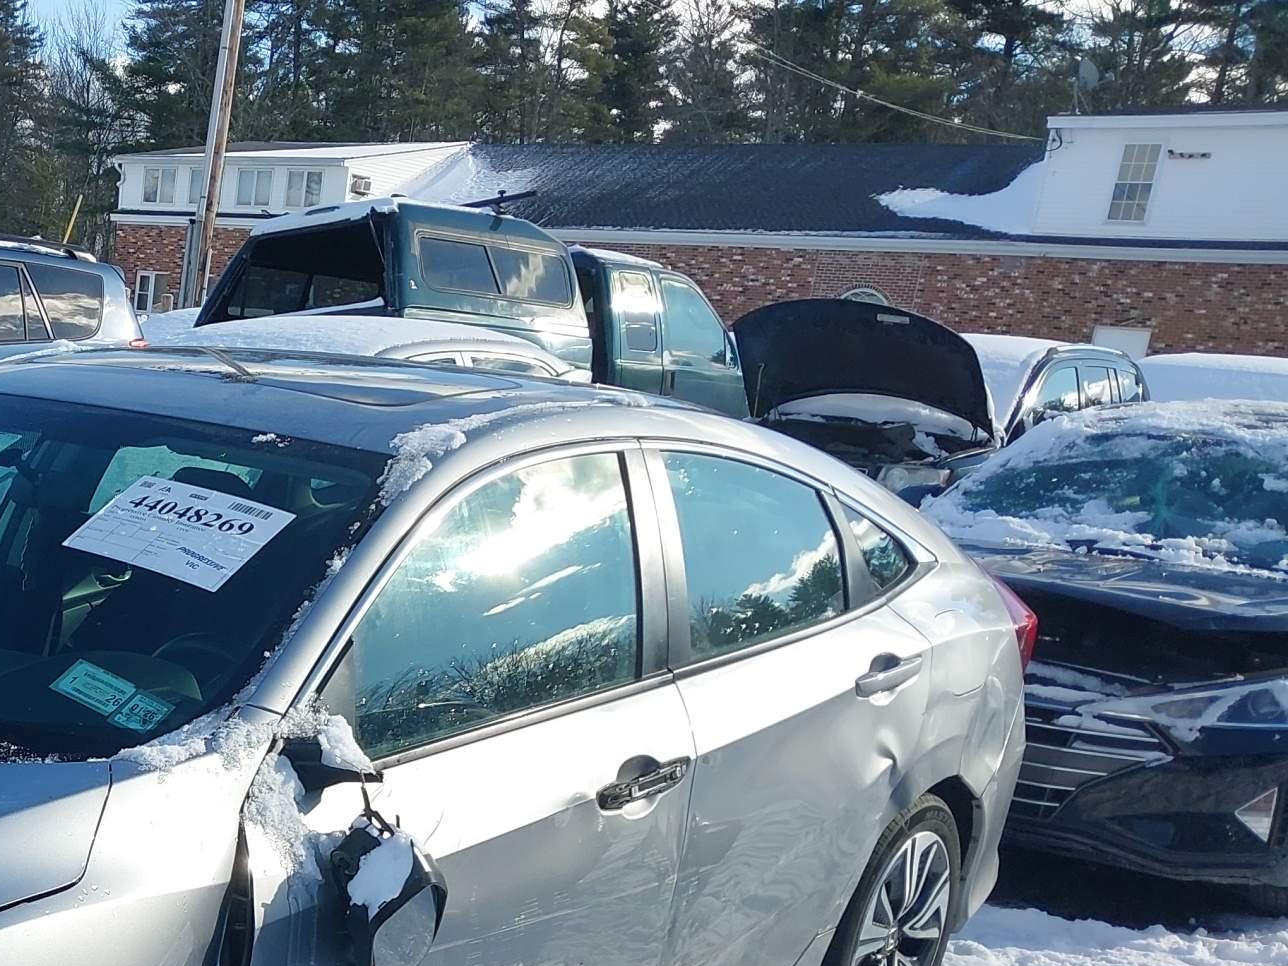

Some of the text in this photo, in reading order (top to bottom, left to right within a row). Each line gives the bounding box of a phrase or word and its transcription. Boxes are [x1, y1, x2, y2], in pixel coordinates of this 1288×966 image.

[129, 495, 255, 537] 44048269
[185, 559, 200, 570] VIC
[105, 694, 123, 707] 26
